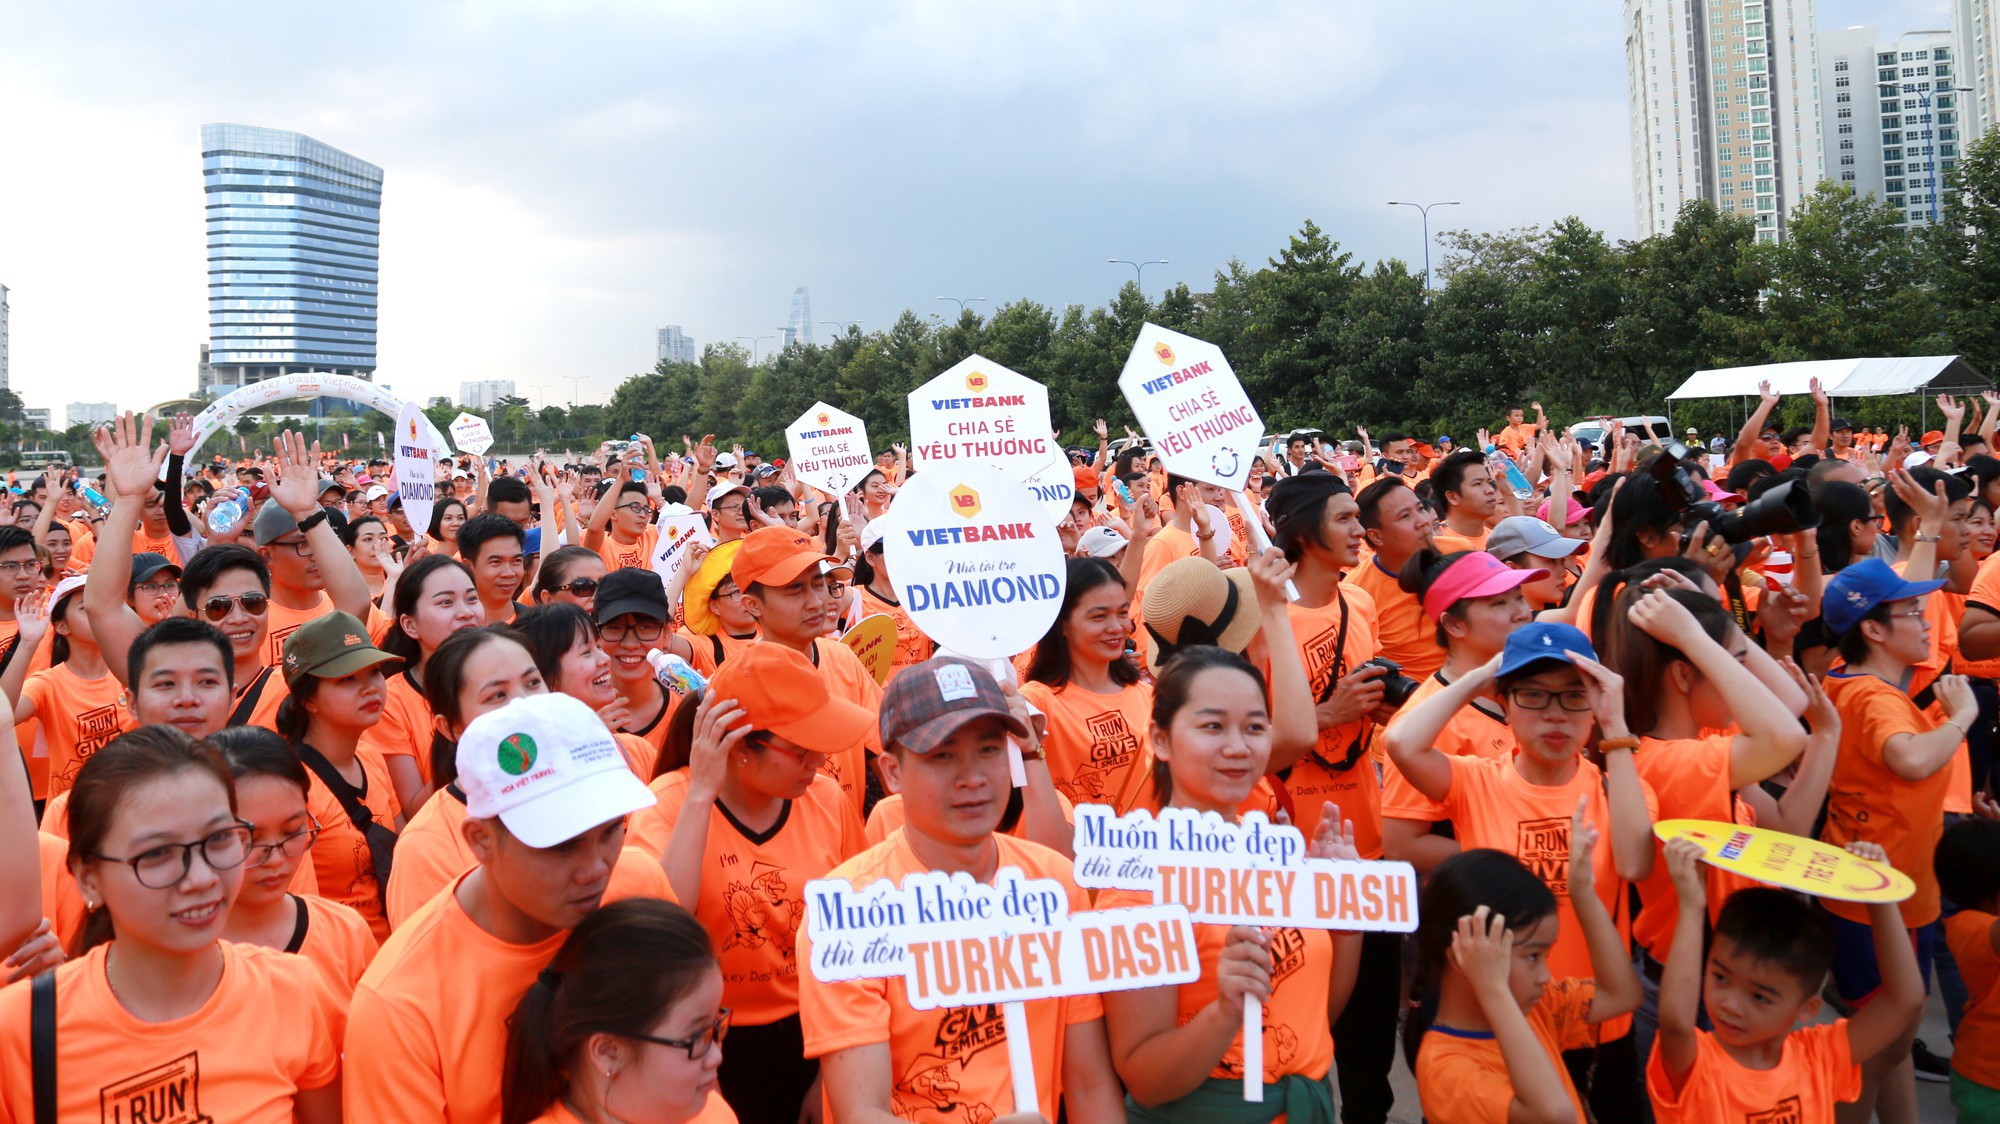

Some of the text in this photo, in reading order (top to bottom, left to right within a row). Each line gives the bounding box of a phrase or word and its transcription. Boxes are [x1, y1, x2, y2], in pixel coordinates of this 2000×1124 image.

[288, 376, 317, 385] Dash
[323, 376, 366, 393] Vietnam
[1142, 360, 1213, 395] VIETBANK
[264, 390, 281, 398] Give
[931, 395, 1026, 410] VIETBANK
[1168, 386, 1221, 422] CHIA SẺ
[456, 423, 481, 431] VIETBANK
[800, 426, 853, 439] VIETBANK
[948, 415, 1015, 436] CHIA SẺ
[1157, 405, 1253, 457] YÊU THƯƠNG
[401, 445, 429, 460] VIETBANK
[812, 445, 835, 456] CHIA
[918, 437, 1046, 461] YÊU THƯƠNG
[797, 454, 869, 473] YÊU THƯƠNG
[401, 481, 434, 501] DIAMOND
[660, 526, 696, 562] VIETBANK
[907, 522, 1035, 547] VIETBANK
[671, 554, 684, 573] CHI
[945, 559, 1017, 575] Nhà tài trợ
[906, 573, 1060, 612] DIAMOND
[89, 713, 113, 734] RUN
[1099, 717, 1124, 738] RUN
[1092, 736, 1137, 760] GIVE
[1101, 755, 1129, 768] SMILES
[501, 784, 515, 795] HOA
[531, 767, 556, 781] TRAVEL
[1297, 785, 1318, 795] Dash
[1322, 782, 1358, 794] Vietnam
[1082, 815, 1296, 867] Muốn khỏe đẹp
[1535, 828, 1569, 851] RUN
[720, 854, 739, 868] I'm
[1082, 854, 1156, 880] thì đến
[816, 879, 1058, 932] Muốn khỏe đẹp
[1157, 865, 1409, 923] TURKEY DASH
[821, 933, 907, 969] thì đến
[908, 919, 1190, 999] TURKEY DASH
[950, 1020, 1006, 1055] SMILES
[130, 1077, 189, 1124] RUN
